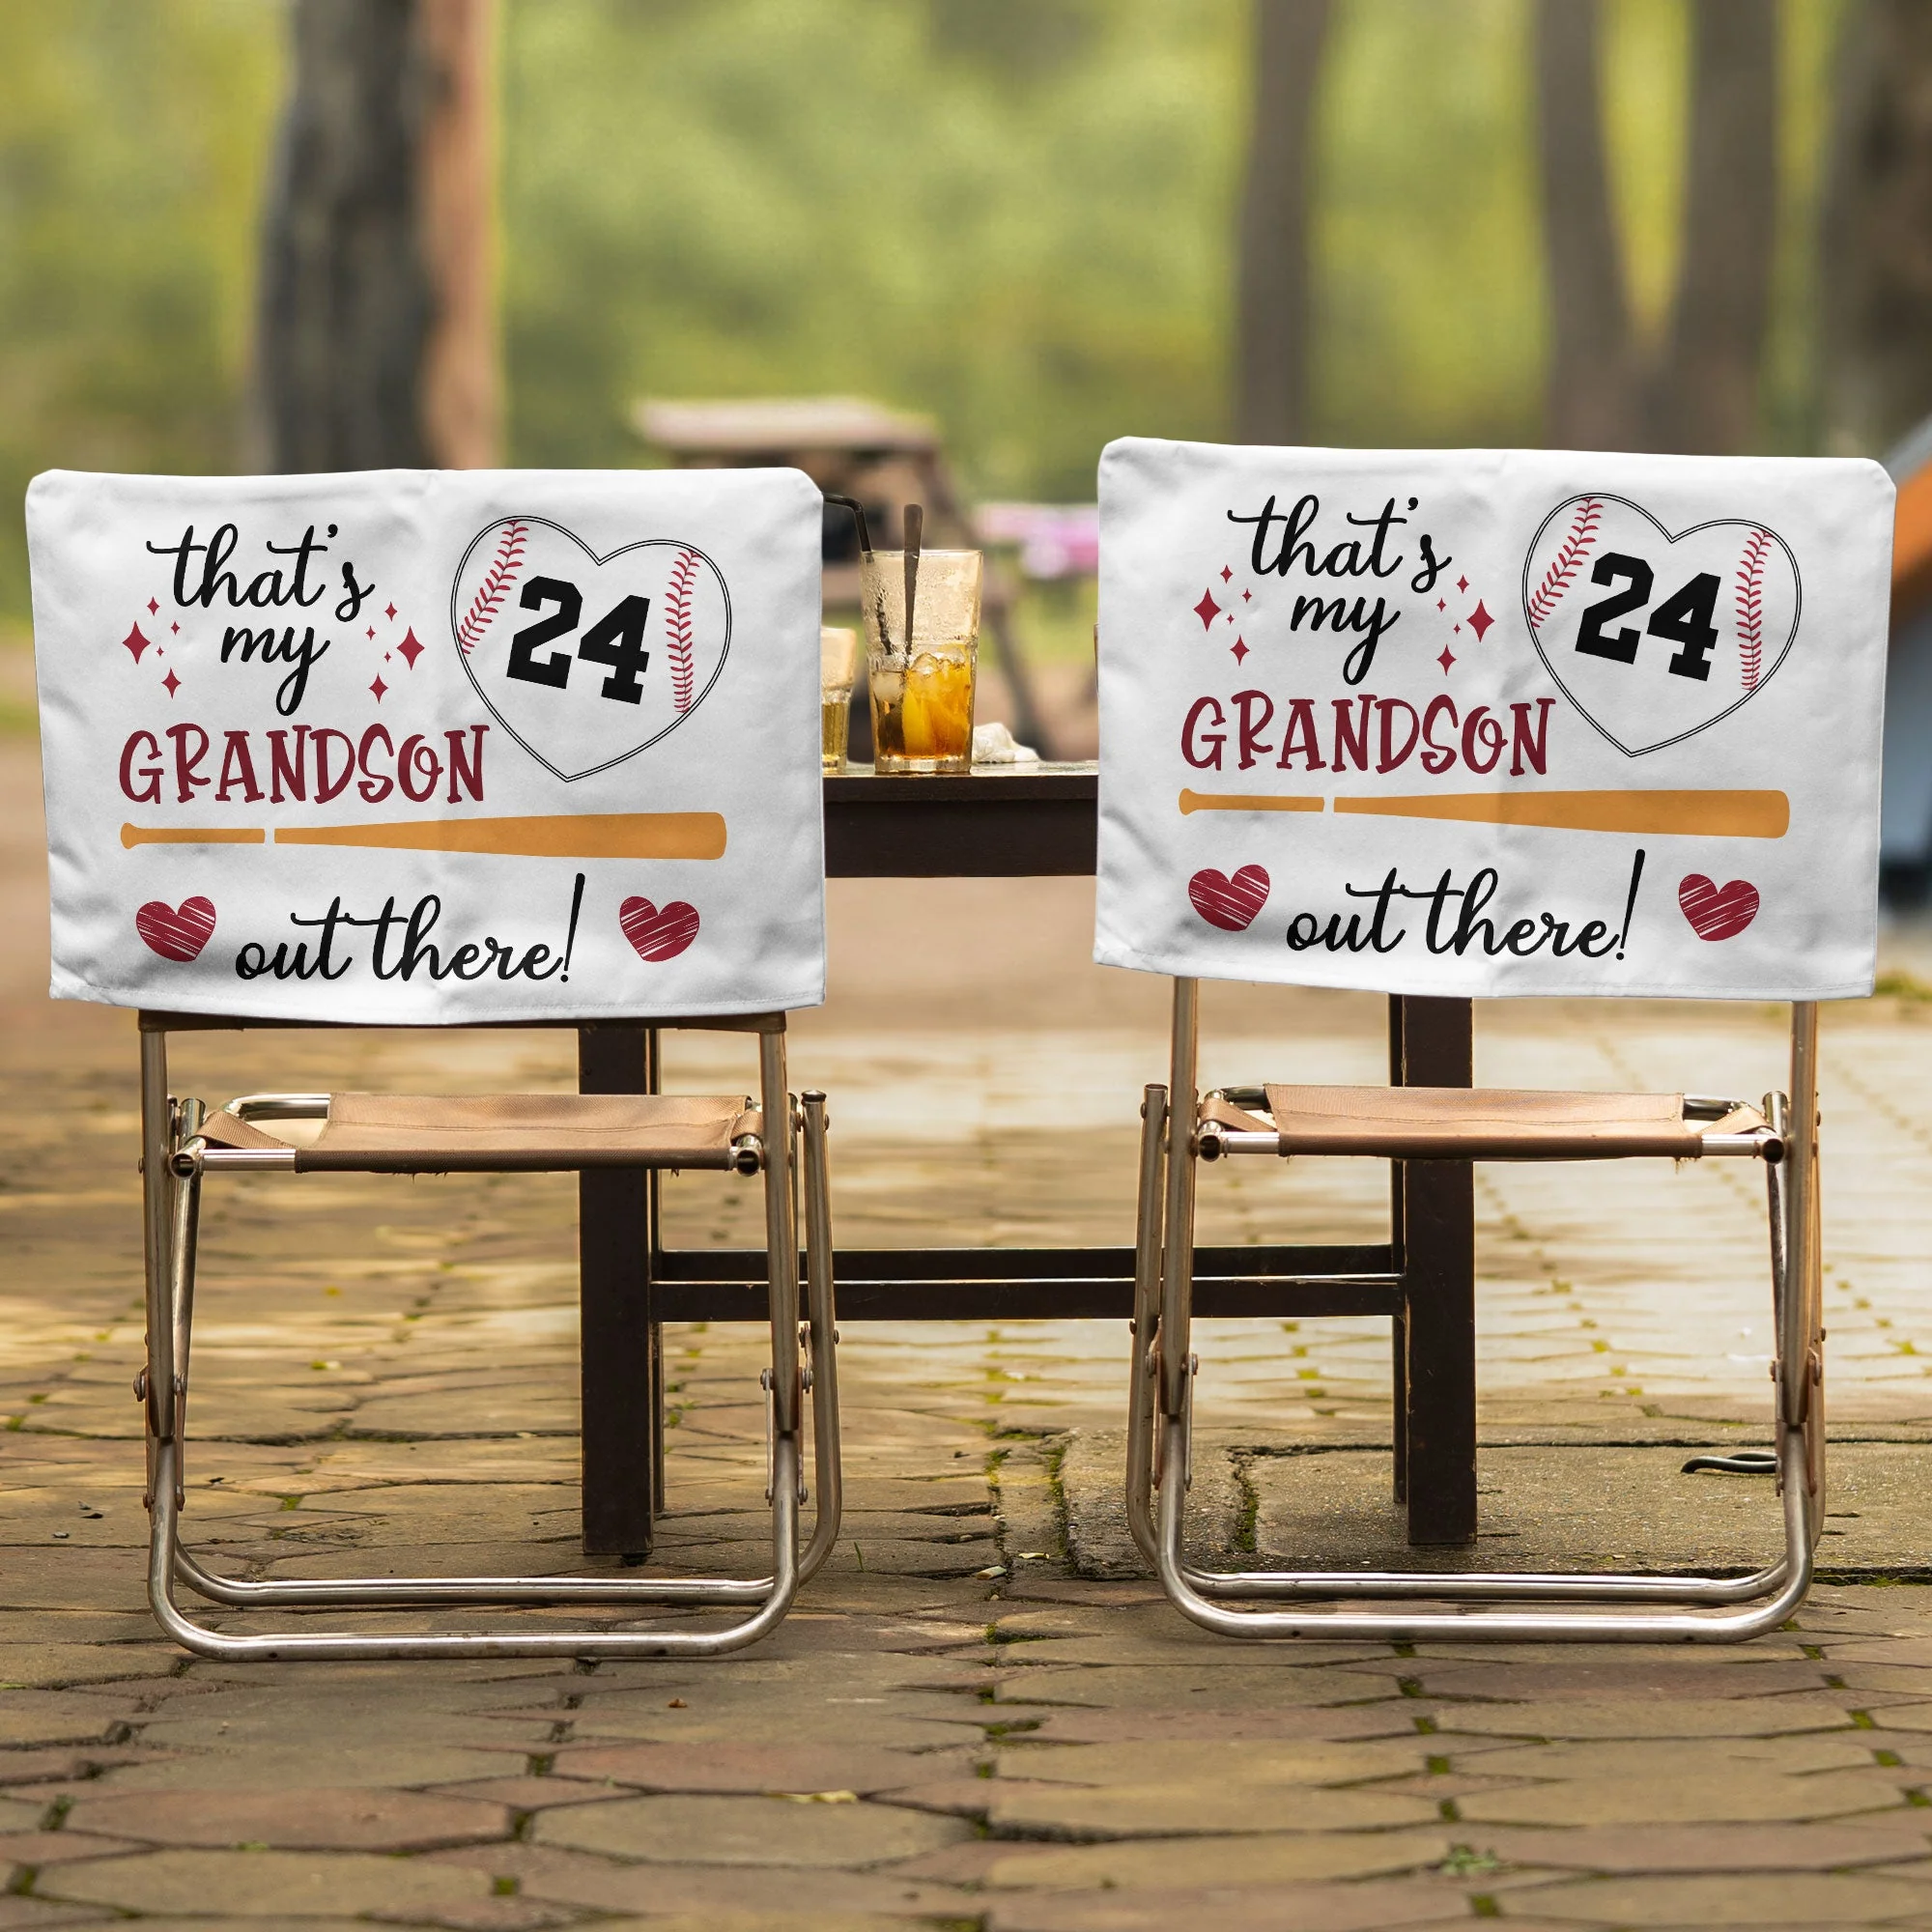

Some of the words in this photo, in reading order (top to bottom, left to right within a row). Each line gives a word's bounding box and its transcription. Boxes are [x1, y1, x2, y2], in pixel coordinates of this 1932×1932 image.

[146, 523, 376, 623] that's
[1227, 494, 1453, 594] that's
[506, 575, 651, 705] 24
[1290, 595, 1402, 686] my
[1575, 552, 1721, 682] 24
[220, 626, 331, 717] my
[120, 724, 490, 805] GRANDSON
[1180, 690, 1555, 777] GRANDSON
[235, 895, 353, 980] out
[343, 872, 585, 983] there!
[1286, 867, 1406, 952] out
[1400, 848, 1646, 960] there!
